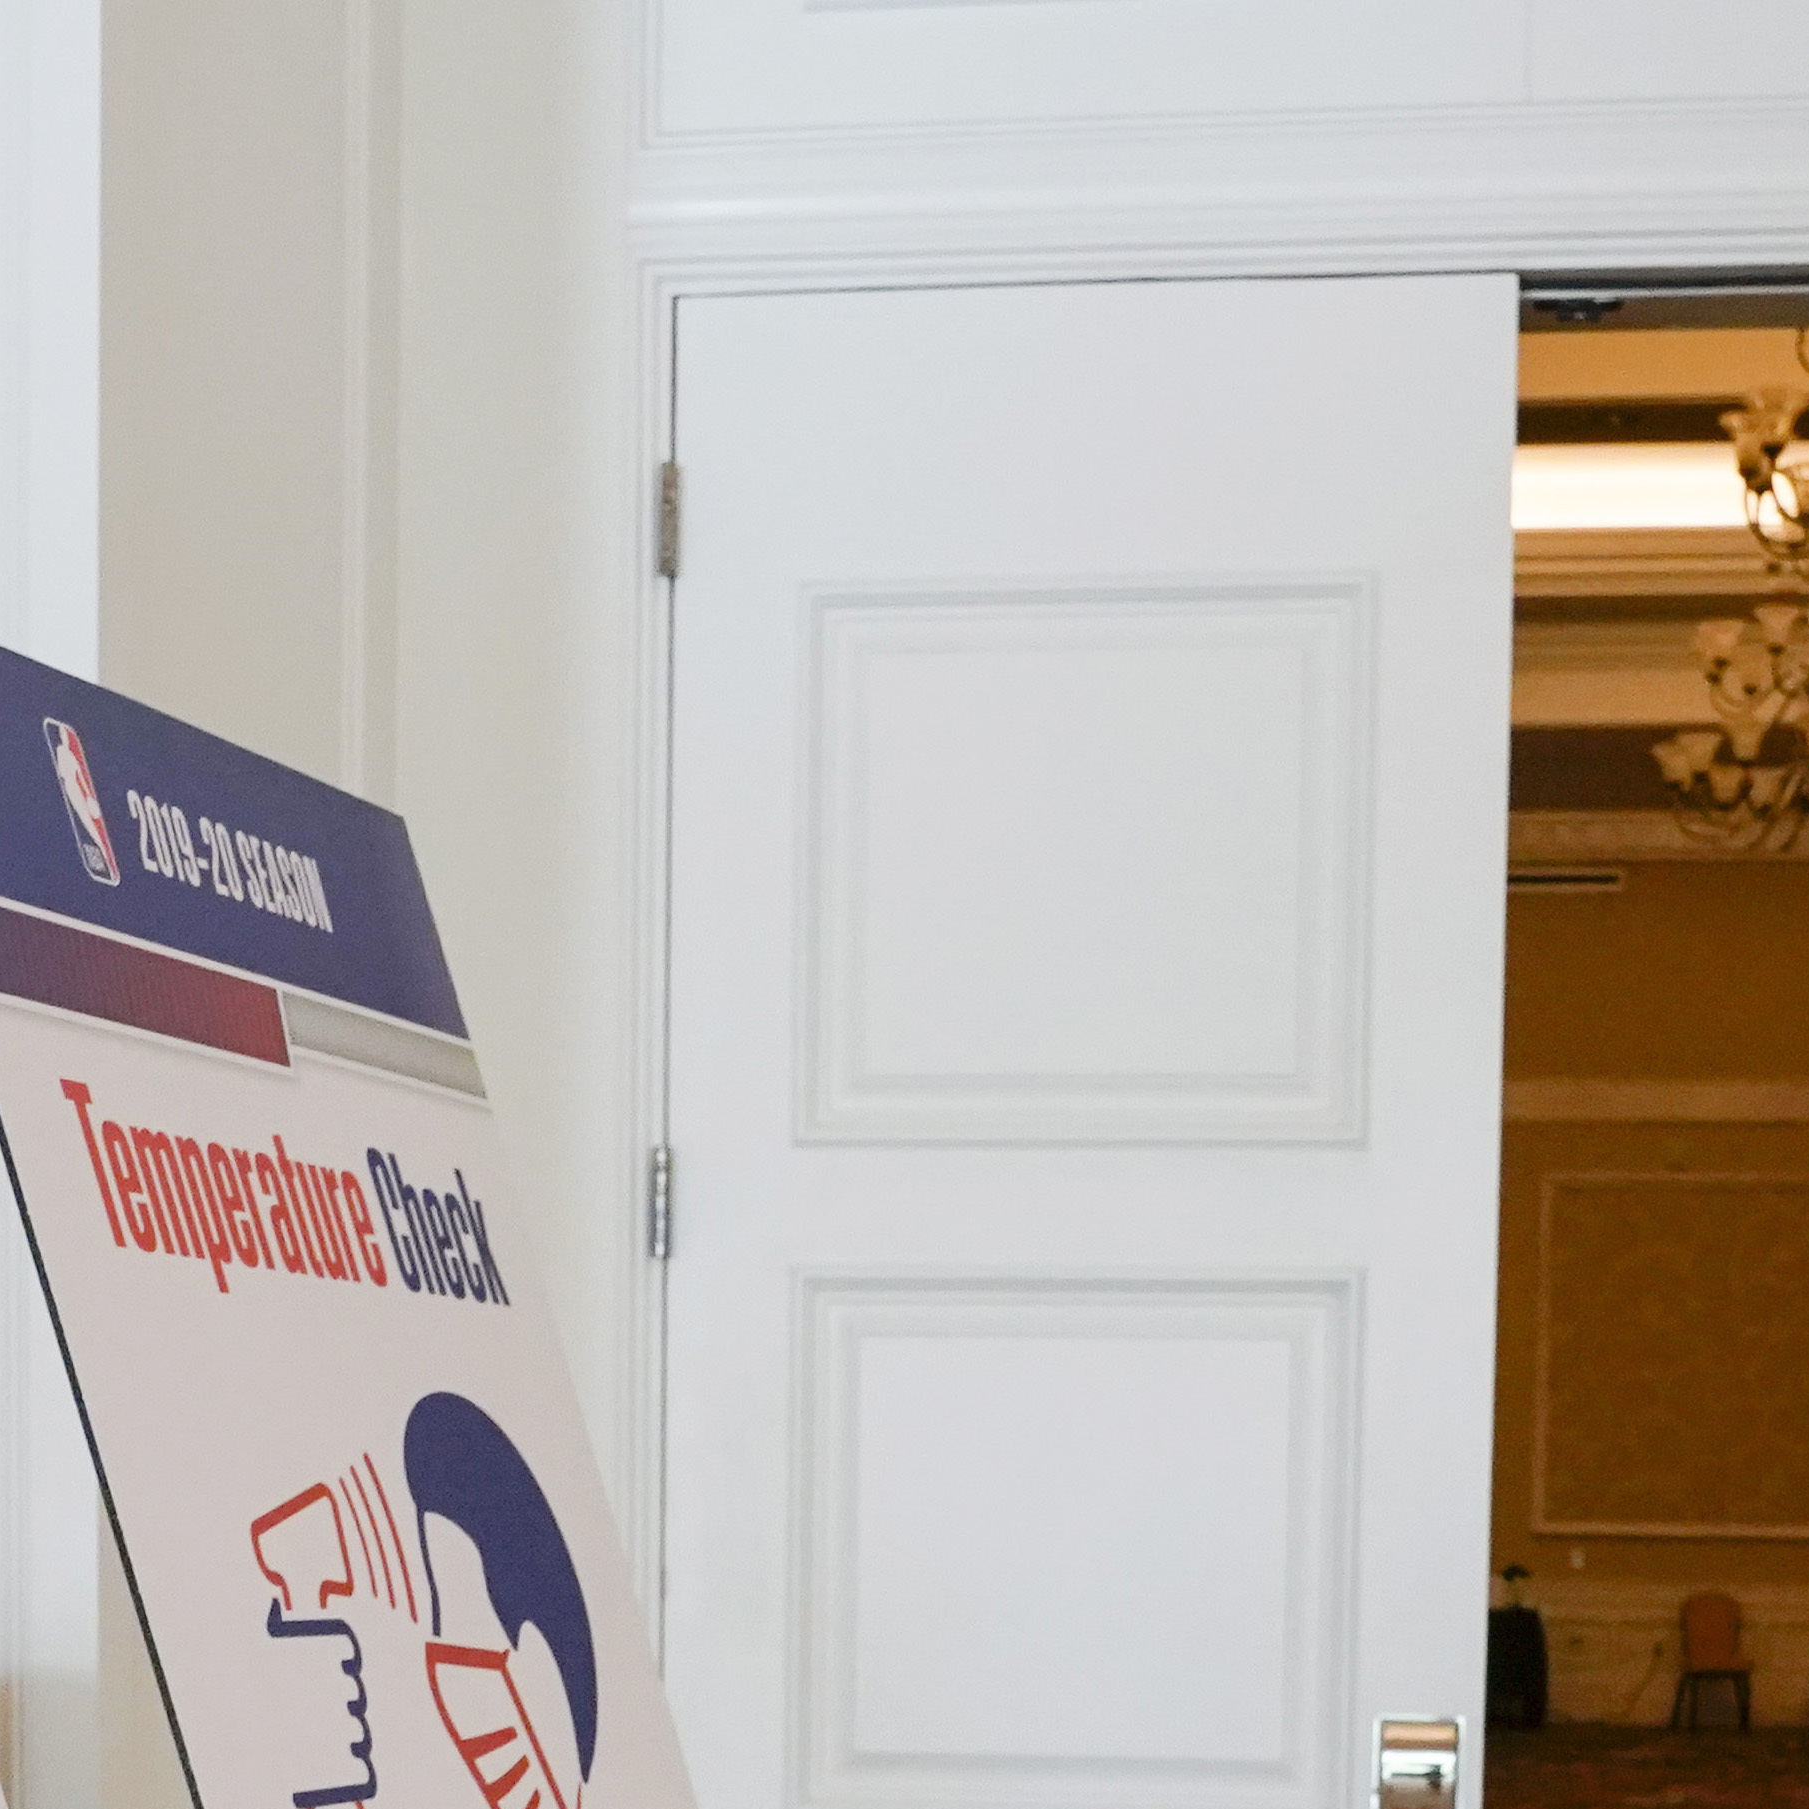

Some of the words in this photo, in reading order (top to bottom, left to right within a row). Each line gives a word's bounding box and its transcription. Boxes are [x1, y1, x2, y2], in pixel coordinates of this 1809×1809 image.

[127, 789, 244, 902] 2019-20
[236, 829, 333, 933] SEASON
[59, 1078, 387, 1293] Temperature
[366, 1146, 510, 1306] Check
